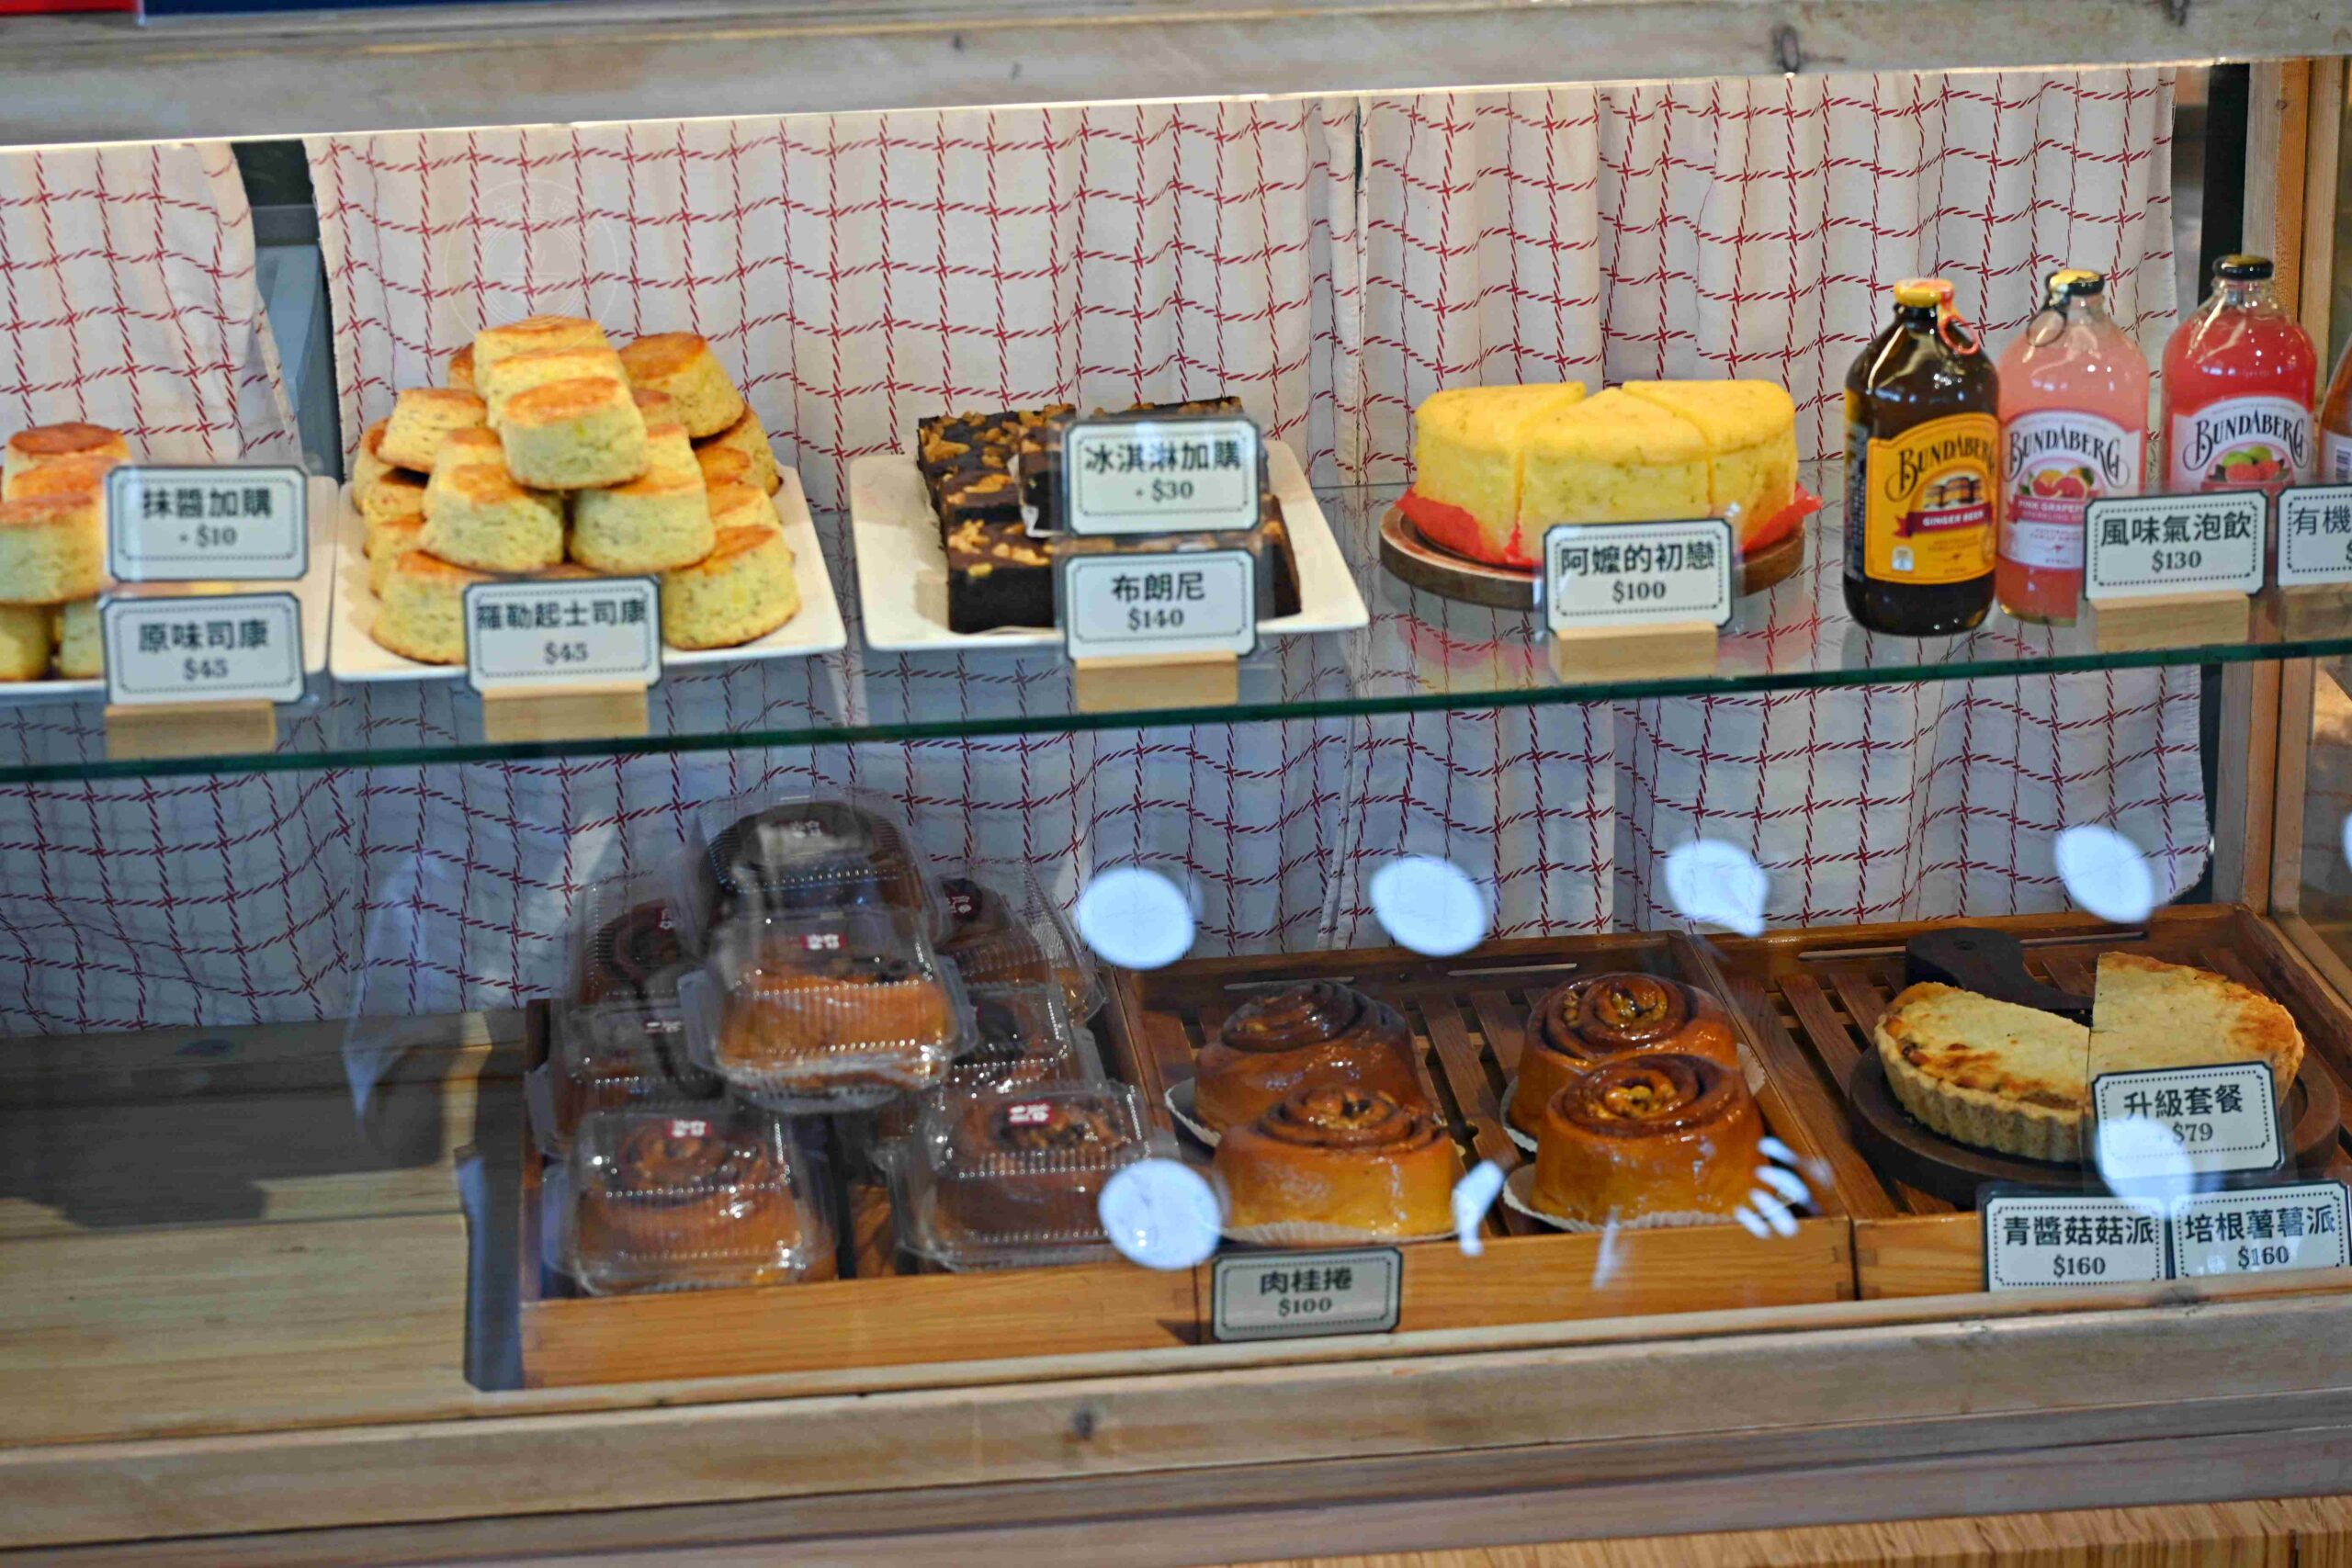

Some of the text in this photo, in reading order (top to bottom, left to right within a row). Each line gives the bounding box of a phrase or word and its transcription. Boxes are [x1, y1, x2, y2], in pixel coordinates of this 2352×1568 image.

[2183, 409, 2309, 471] BUNDABERG
[2002, 424, 2130, 488] BUNDABERG
[1922, 514, 1962, 526] GINGER
[2101, 510, 2252, 547] 風味氣泡飲
[1561, 541, 1715, 576] 阿嬤的初戀
[2152, 550, 2201, 573] $130
[1113, 572, 1205, 603] 布朗尼
[1612, 581, 1666, 604] $100
[1127, 608, 1184, 632] $140
[140, 620, 268, 652] 原味司康
[544, 642, 588, 665] $45
[183, 657, 228, 681] $45
[2123, 1084, 2243, 1121] 升級套餐
[2172, 1122, 2213, 1145] $79
[2003, 1215, 2154, 1247] 青醬菇菇派
[2185, 1204, 2335, 1243] 培根薯薯派
[2052, 1254, 2106, 1279] $160
[2237, 1246, 2290, 1270] $160
[1260, 1267, 1352, 1295] 肉桂捲
[1279, 1298, 1332, 1316] $100
